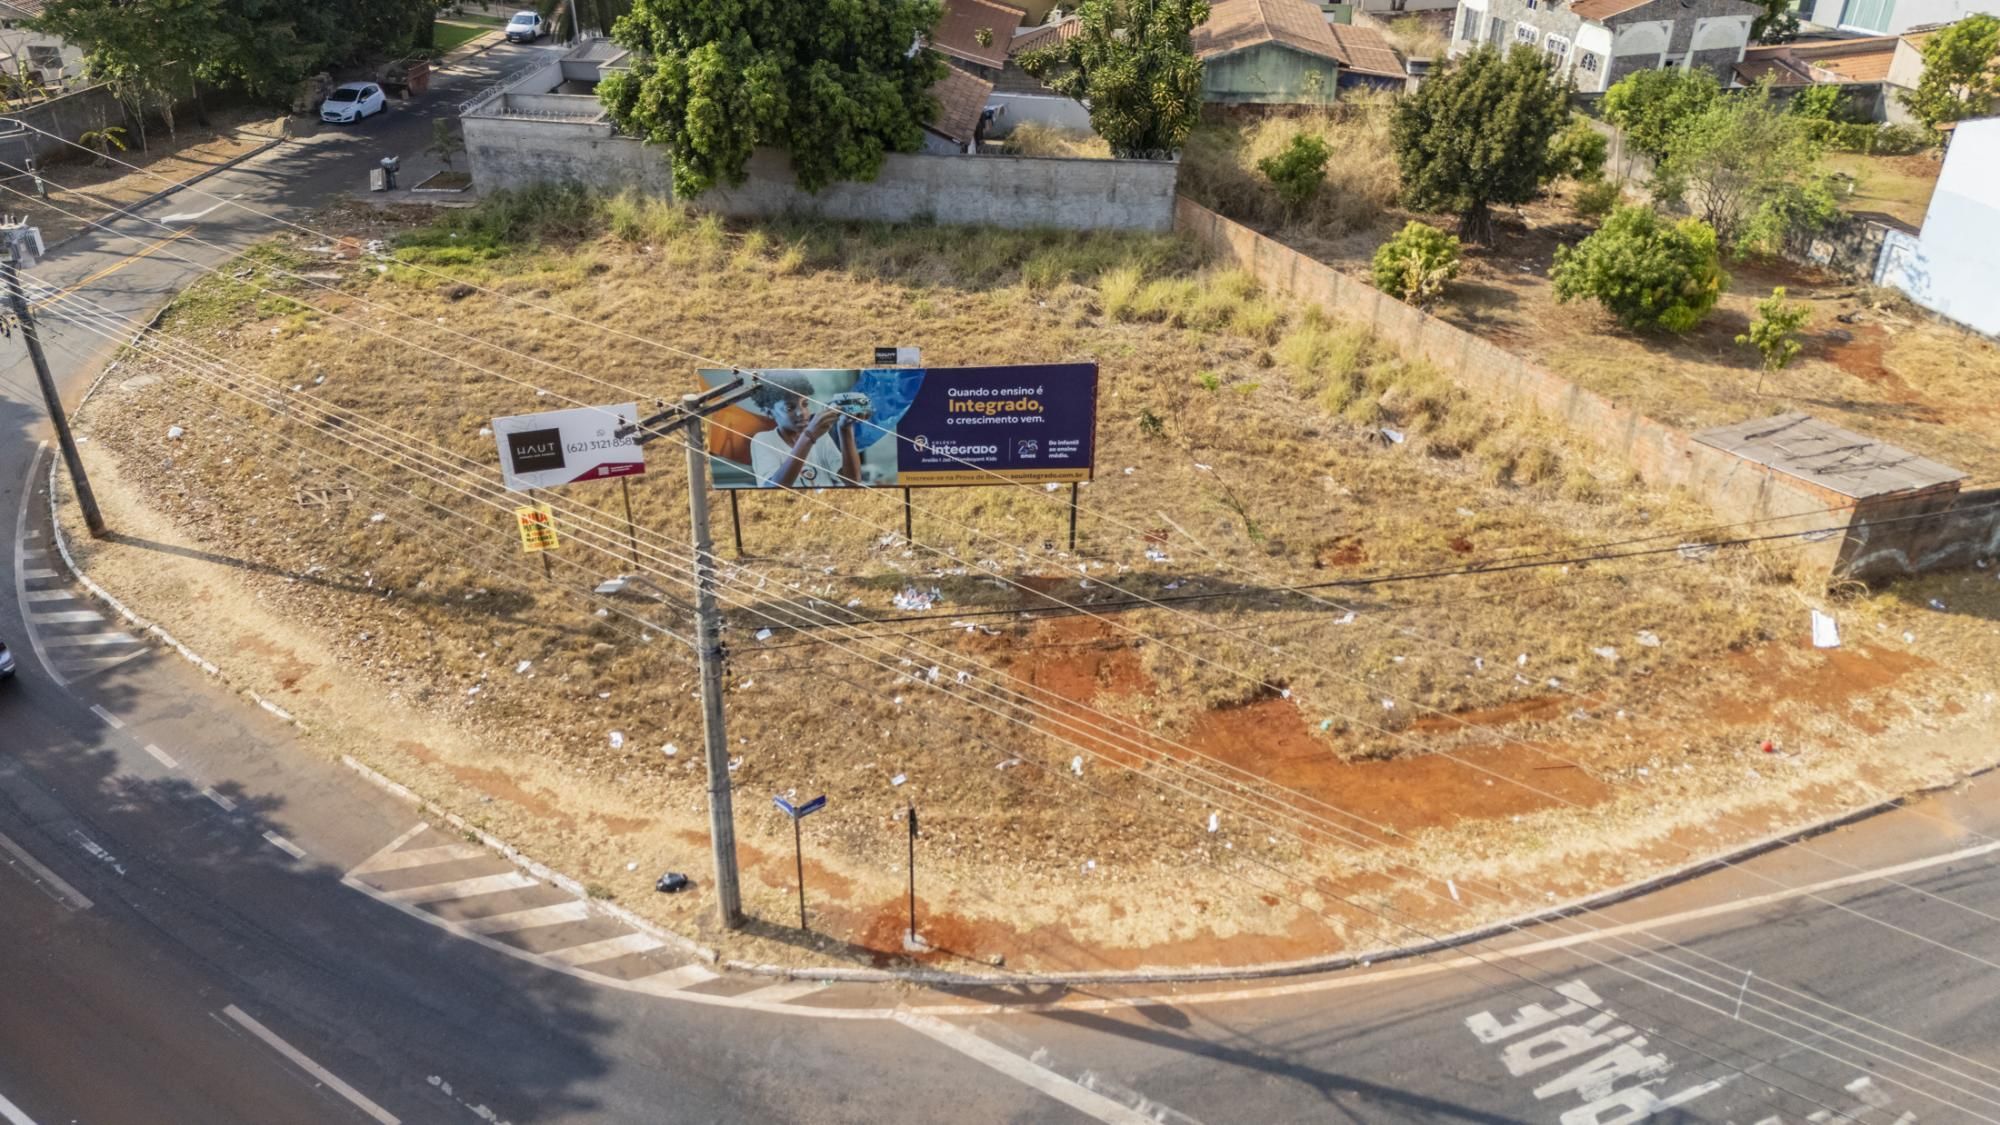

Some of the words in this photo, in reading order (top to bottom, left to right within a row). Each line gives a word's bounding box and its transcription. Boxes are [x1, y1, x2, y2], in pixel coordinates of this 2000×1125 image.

[948, 387, 990, 396] Quando
[991, 388, 999, 396] o
[1000, 386, 1035, 396] ensino
[1036, 385, 1044, 395] é
[949, 397, 1044, 415] Integrado,
[955, 415, 1019, 425] crescimento
[1020, 415, 1045, 423] vem.
[516, 442, 555, 455] HAUT
[566, 443, 588, 454] (62)
